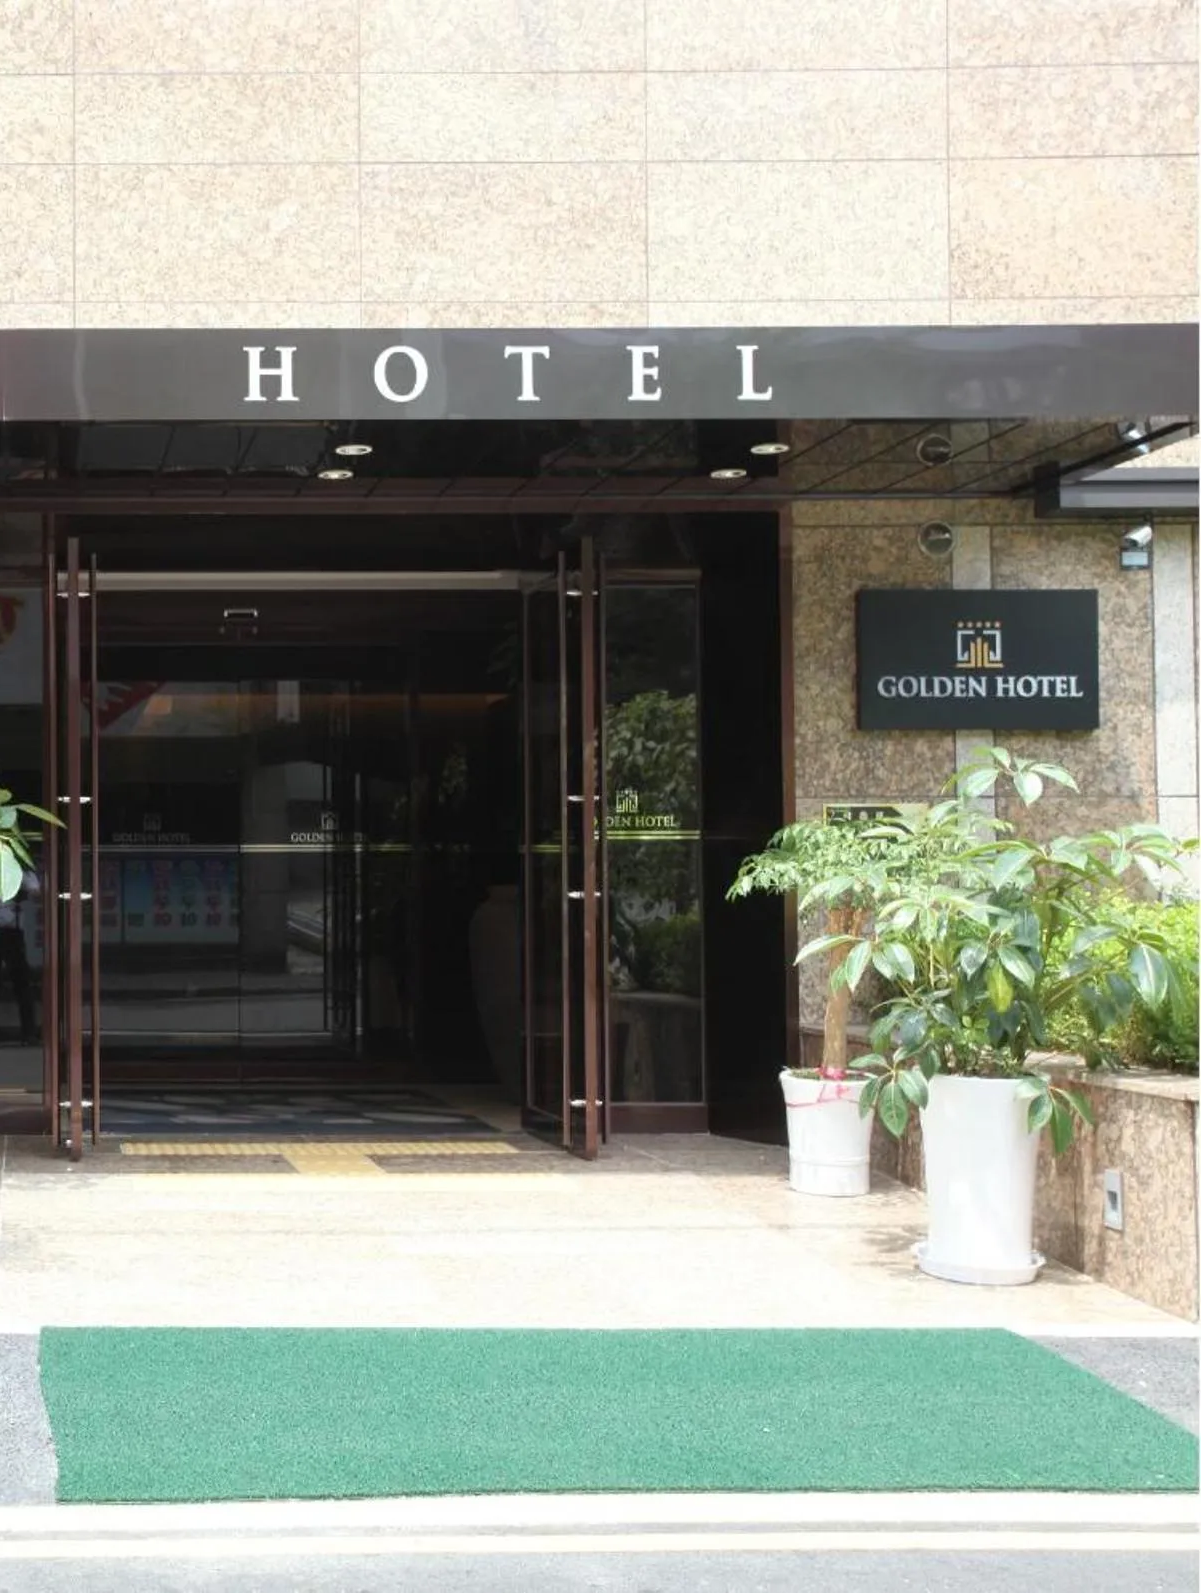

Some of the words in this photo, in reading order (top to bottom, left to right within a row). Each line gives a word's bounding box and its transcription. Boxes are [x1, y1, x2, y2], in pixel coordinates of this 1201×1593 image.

[242, 345, 774, 402] HOTEL
[877, 676, 987, 698] GOLDEN
[997, 676, 1084, 698] HOTEL
[635, 815, 678, 827] HOTEL
